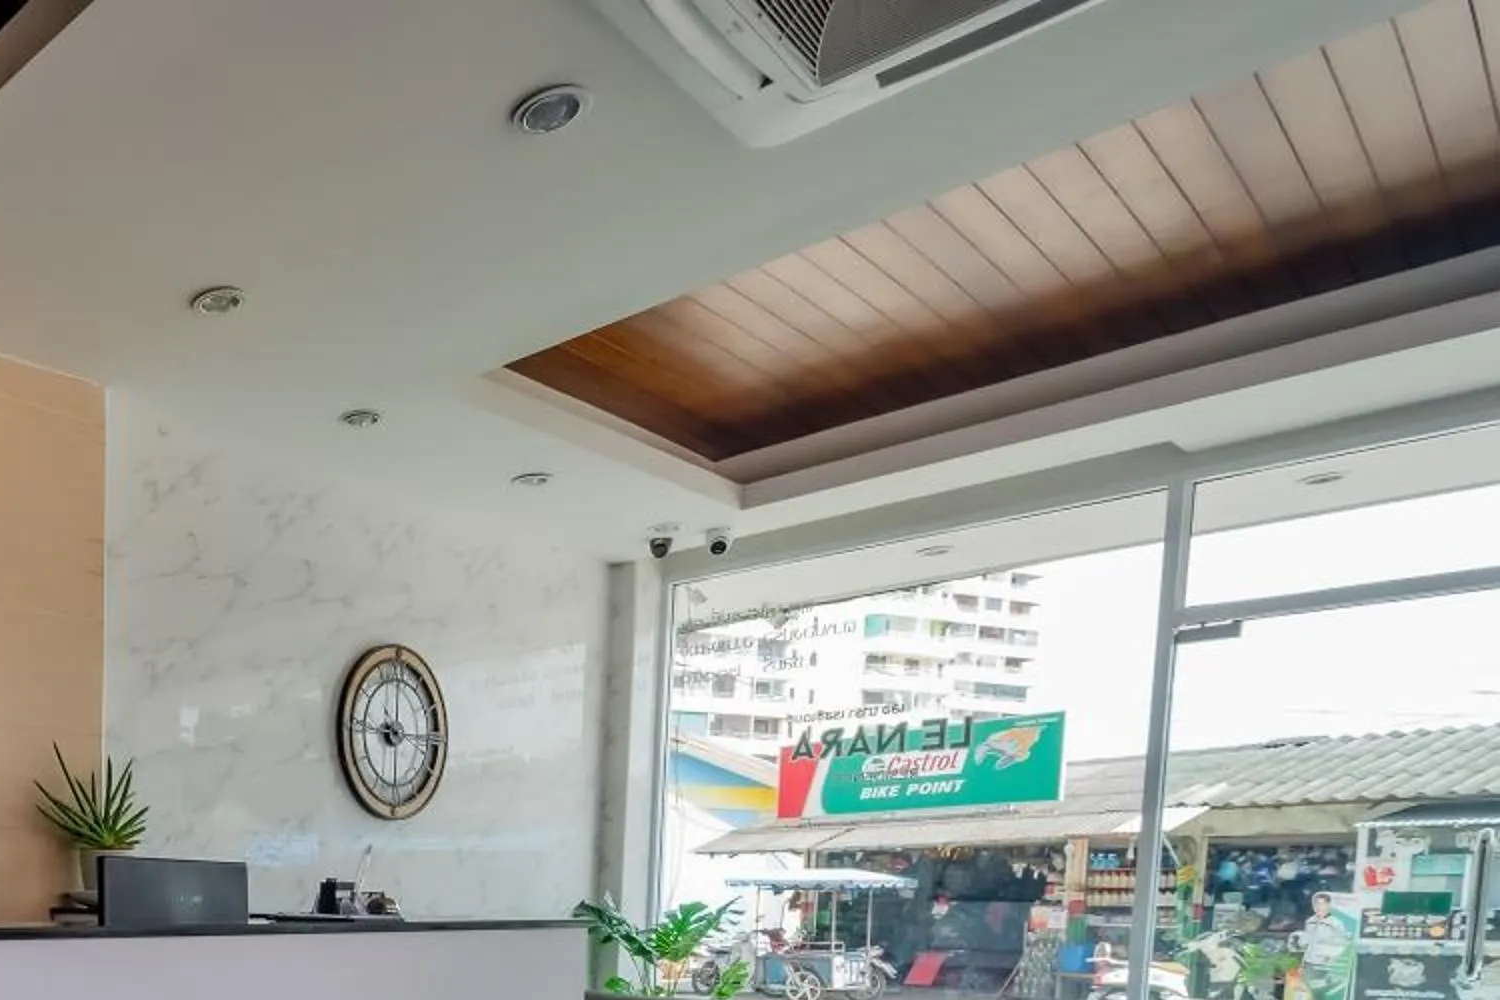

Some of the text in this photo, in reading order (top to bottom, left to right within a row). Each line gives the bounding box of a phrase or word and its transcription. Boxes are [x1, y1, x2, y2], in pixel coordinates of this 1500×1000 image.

[887, 750, 960, 772] Castrol
[859, 779, 966, 801] BIKE POINT
